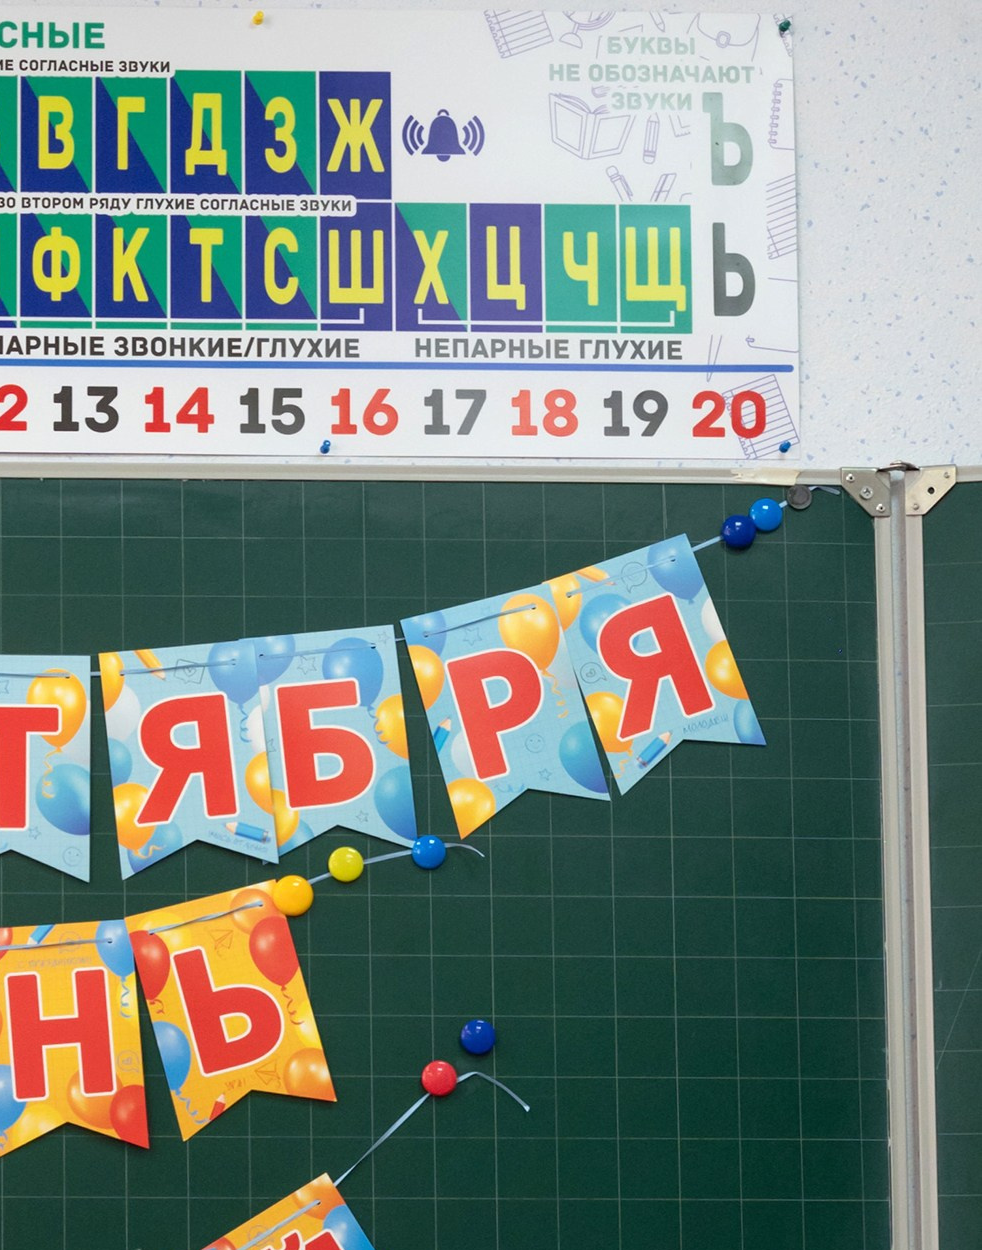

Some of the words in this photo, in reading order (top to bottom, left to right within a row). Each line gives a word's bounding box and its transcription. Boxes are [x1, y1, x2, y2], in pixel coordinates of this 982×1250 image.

[607, 36, 695, 55] БУКВЫ
[19, 60, 113, 71] СОГЛАСНЫЕ
[119, 61, 169, 72] ЗВУКИ
[549, 64, 580, 82] НЕ
[588, 65, 755, 84] ОБОЗНАЧАЮТ
[611, 92, 692, 111] ЗВУКИ
[39, 96, 74, 169] В
[118, 97, 144, 169] Г
[186, 94, 226, 175] Д
[265, 97, 296, 173] З
[327, 99, 384, 172] Ж
[702, 92, 754, 186] Ъ
[22, 197, 83, 209] ВТОРОМ
[89, 197, 131, 211] РЯДУ
[136, 198, 195, 211] ГЛУХИЕ
[200, 198, 295, 212] СОГЛАСНЫЕ
[300, 199, 352, 212] ЗВУКИ
[33, 227, 80, 301] Ф
[113, 228, 148, 301] К
[190, 229, 223, 302] Т
[265, 228, 298, 304] С
[329, 230, 384, 303] Ш
[414, 231, 448, 304] Х
[488, 226, 524, 308] Ц
[563, 233, 598, 305] Ч
[626, 229, 686, 311] Щ
[713, 223, 755, 316] Ь
[114, 336, 360, 359] ЗВОНКИЕ/ГЛУХИЕ
[415, 338, 569, 360] НЕПАРНЫЕ
[579, 339, 682, 361] ГЛУХИЕ
[54, 386, 119, 433] 13
[145, 387, 214, 433] 14
[240, 388, 305, 435] 15
[331, 388, 398, 435] 16
[424, 389, 486, 435] 17
[512, 389, 578, 437] 18
[604, 390, 668, 436] 19
[692, 390, 767, 439] 20
